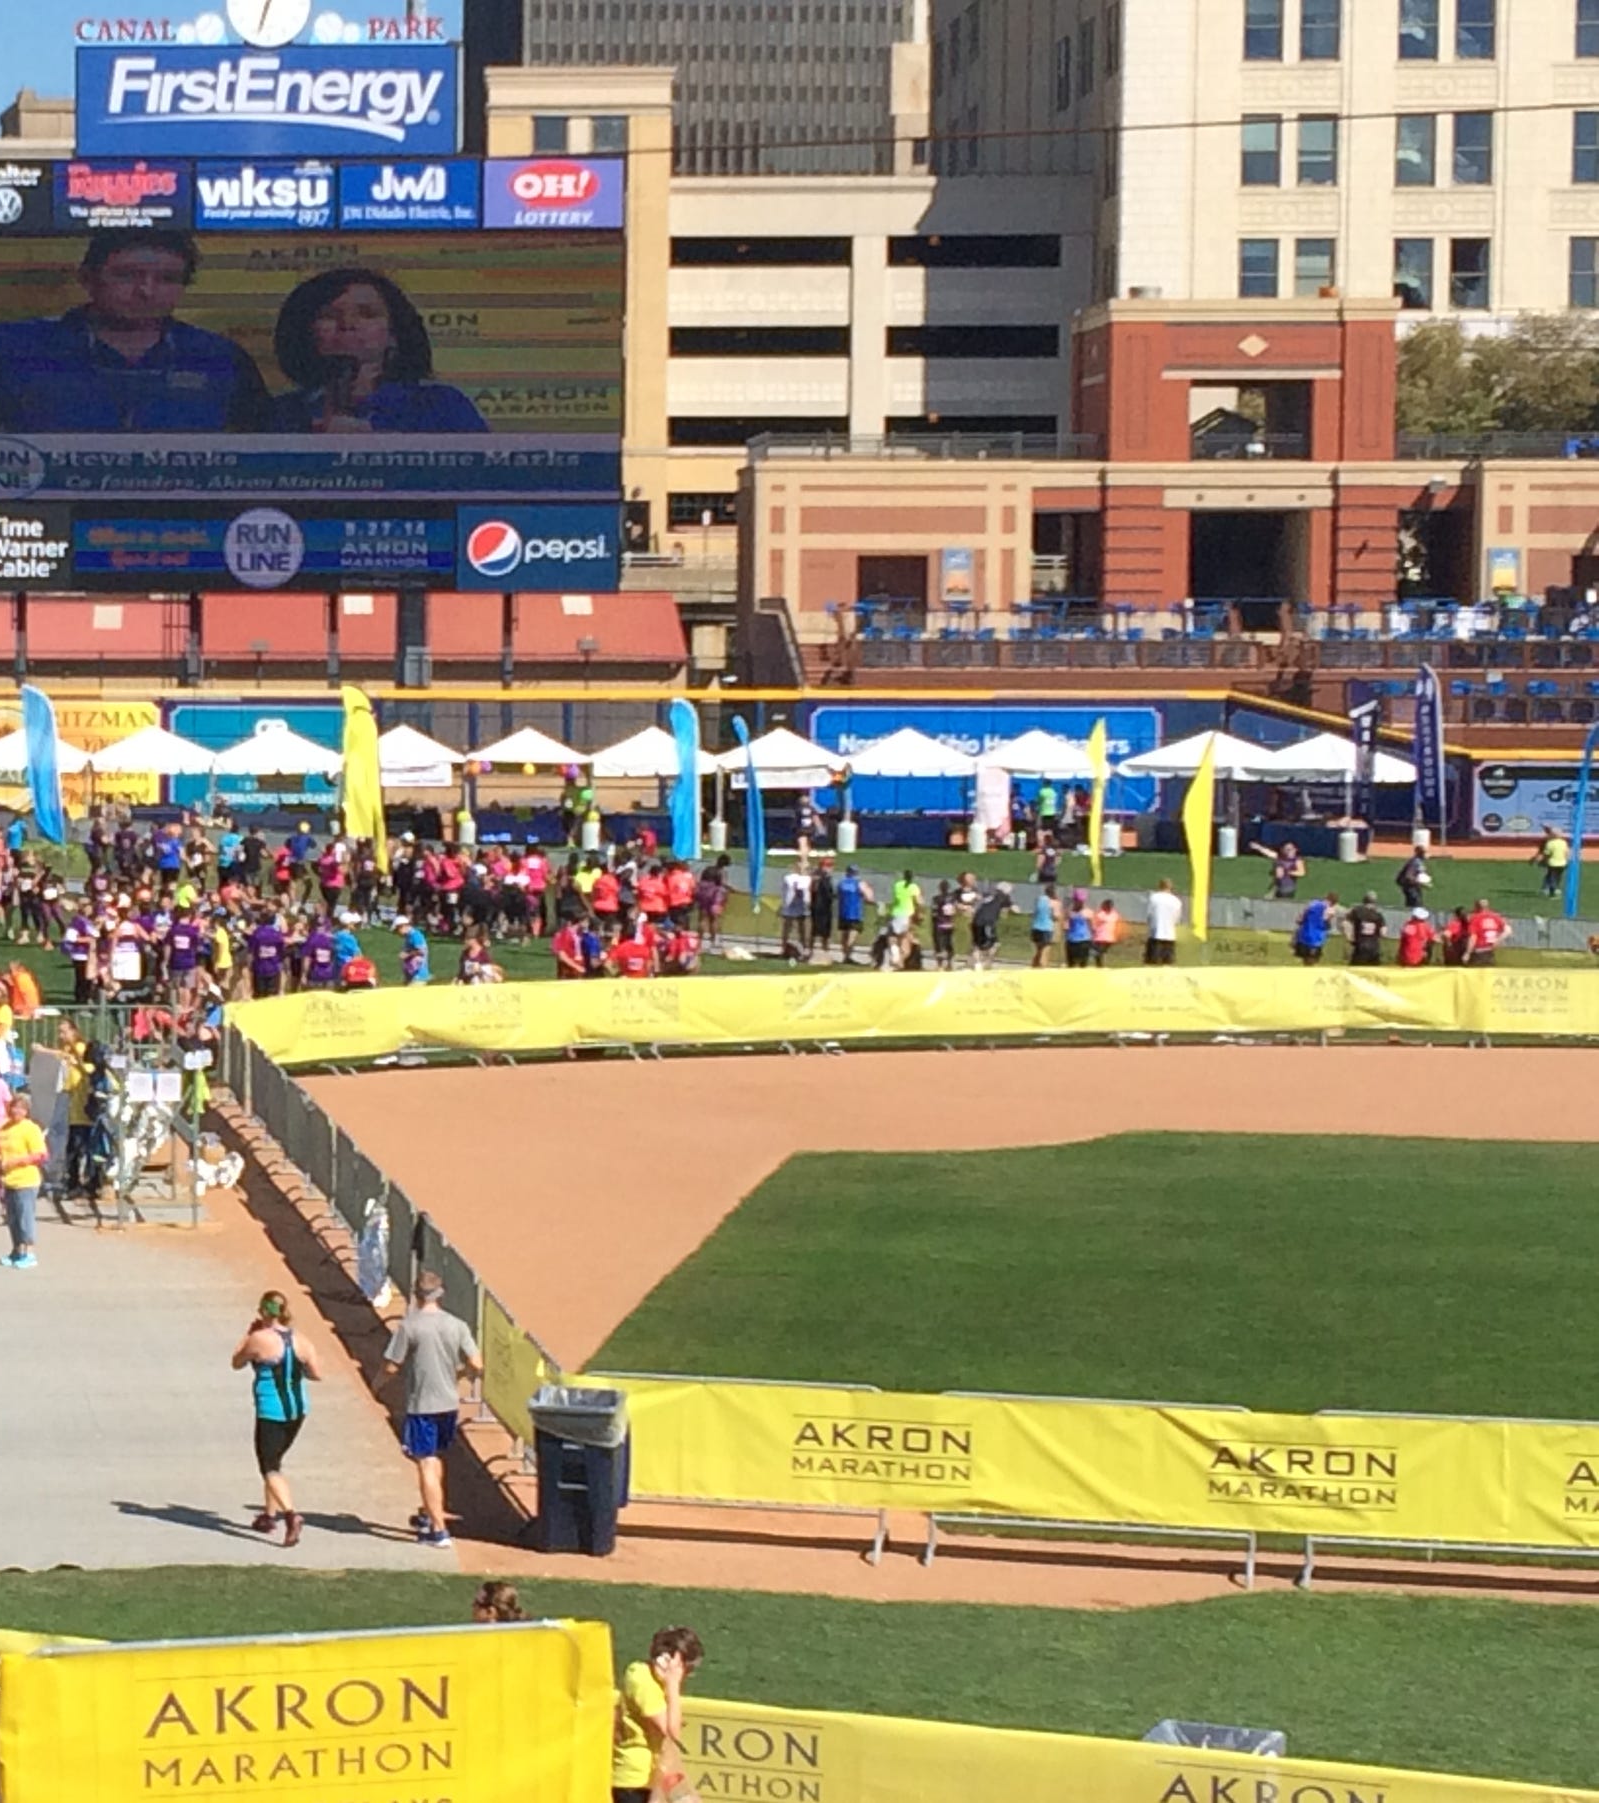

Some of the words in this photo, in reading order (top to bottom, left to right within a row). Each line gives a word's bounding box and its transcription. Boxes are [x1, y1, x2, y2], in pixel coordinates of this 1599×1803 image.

[75, 19, 178, 42] CANAL
[368, 16, 445, 40] PARK
[108, 57, 444, 126] FirstEnergy
[198, 168, 328, 207] wksu
[513, 172, 589, 199] OH!
[513, 210, 592, 227] LOTTERY
[50, 449, 134, 467] Steve
[144, 448, 239, 467] Marks
[236, 522, 292, 545] RUN
[340, 541, 429, 555] AKRON
[523, 534, 606, 564] pepsi
[236, 552, 292, 572] LINE
[340, 557, 429, 568] MARATHON
[1491, 975, 1570, 990] AKRON
[793, 1421, 972, 1455] AKRON
[791, 1455, 972, 1481] MARATHON
[1210, 1446, 1397, 1479] AKRON
[1208, 1479, 1397, 1505] MARATHON
[143, 1674, 452, 1740] AKRON
[674, 1722, 818, 1769] RON
[143, 1741, 454, 1790] MARATHON
[695, 1770, 821, 1803] ATHON
